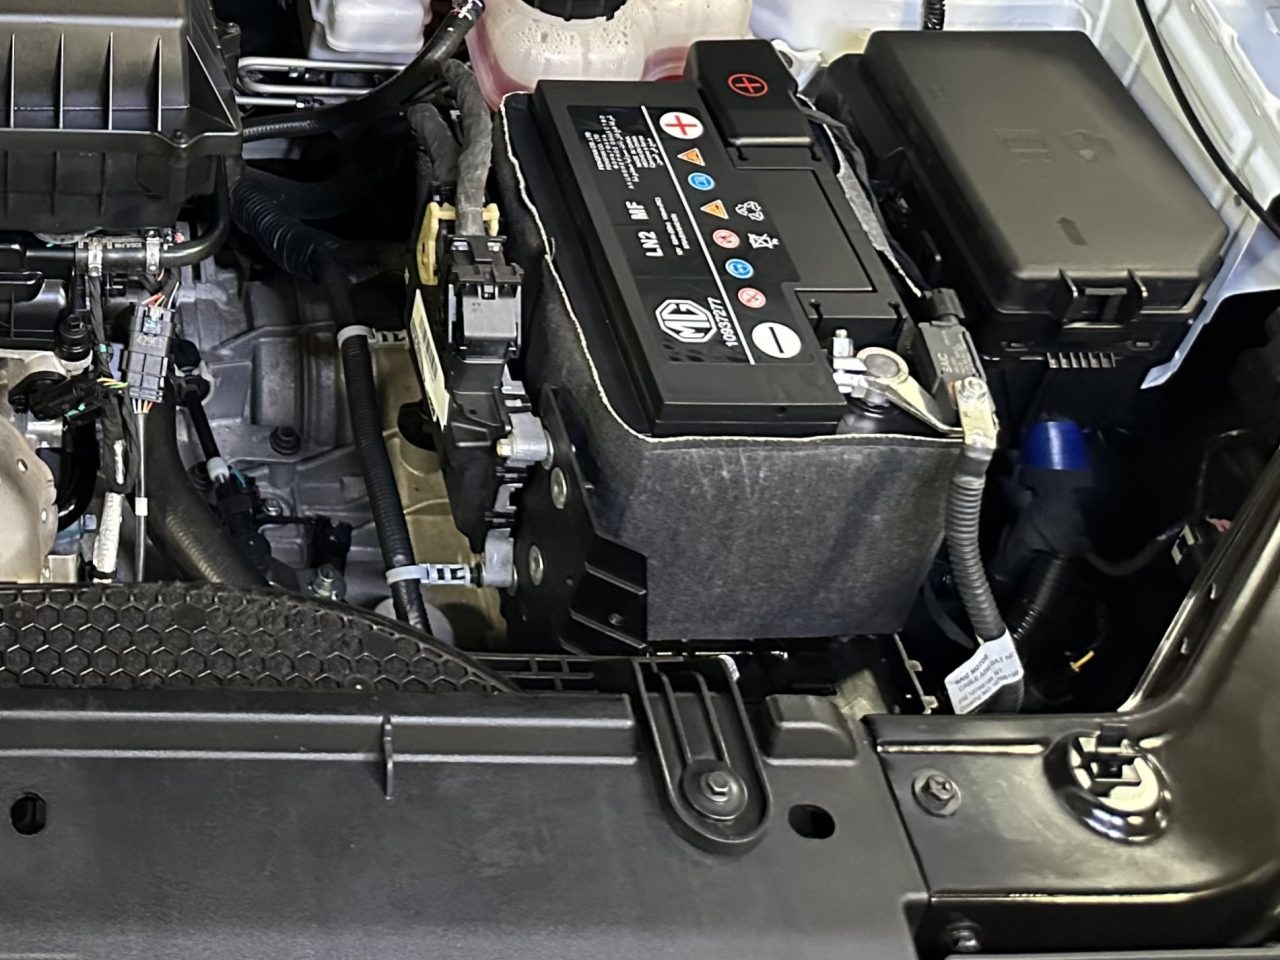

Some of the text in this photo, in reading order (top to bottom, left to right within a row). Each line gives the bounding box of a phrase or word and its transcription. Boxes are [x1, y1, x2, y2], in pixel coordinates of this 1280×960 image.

[625, 201, 664, 257] LN2 MF
[658, 302, 714, 341] MG
[707, 297, 739, 347] 10937277
